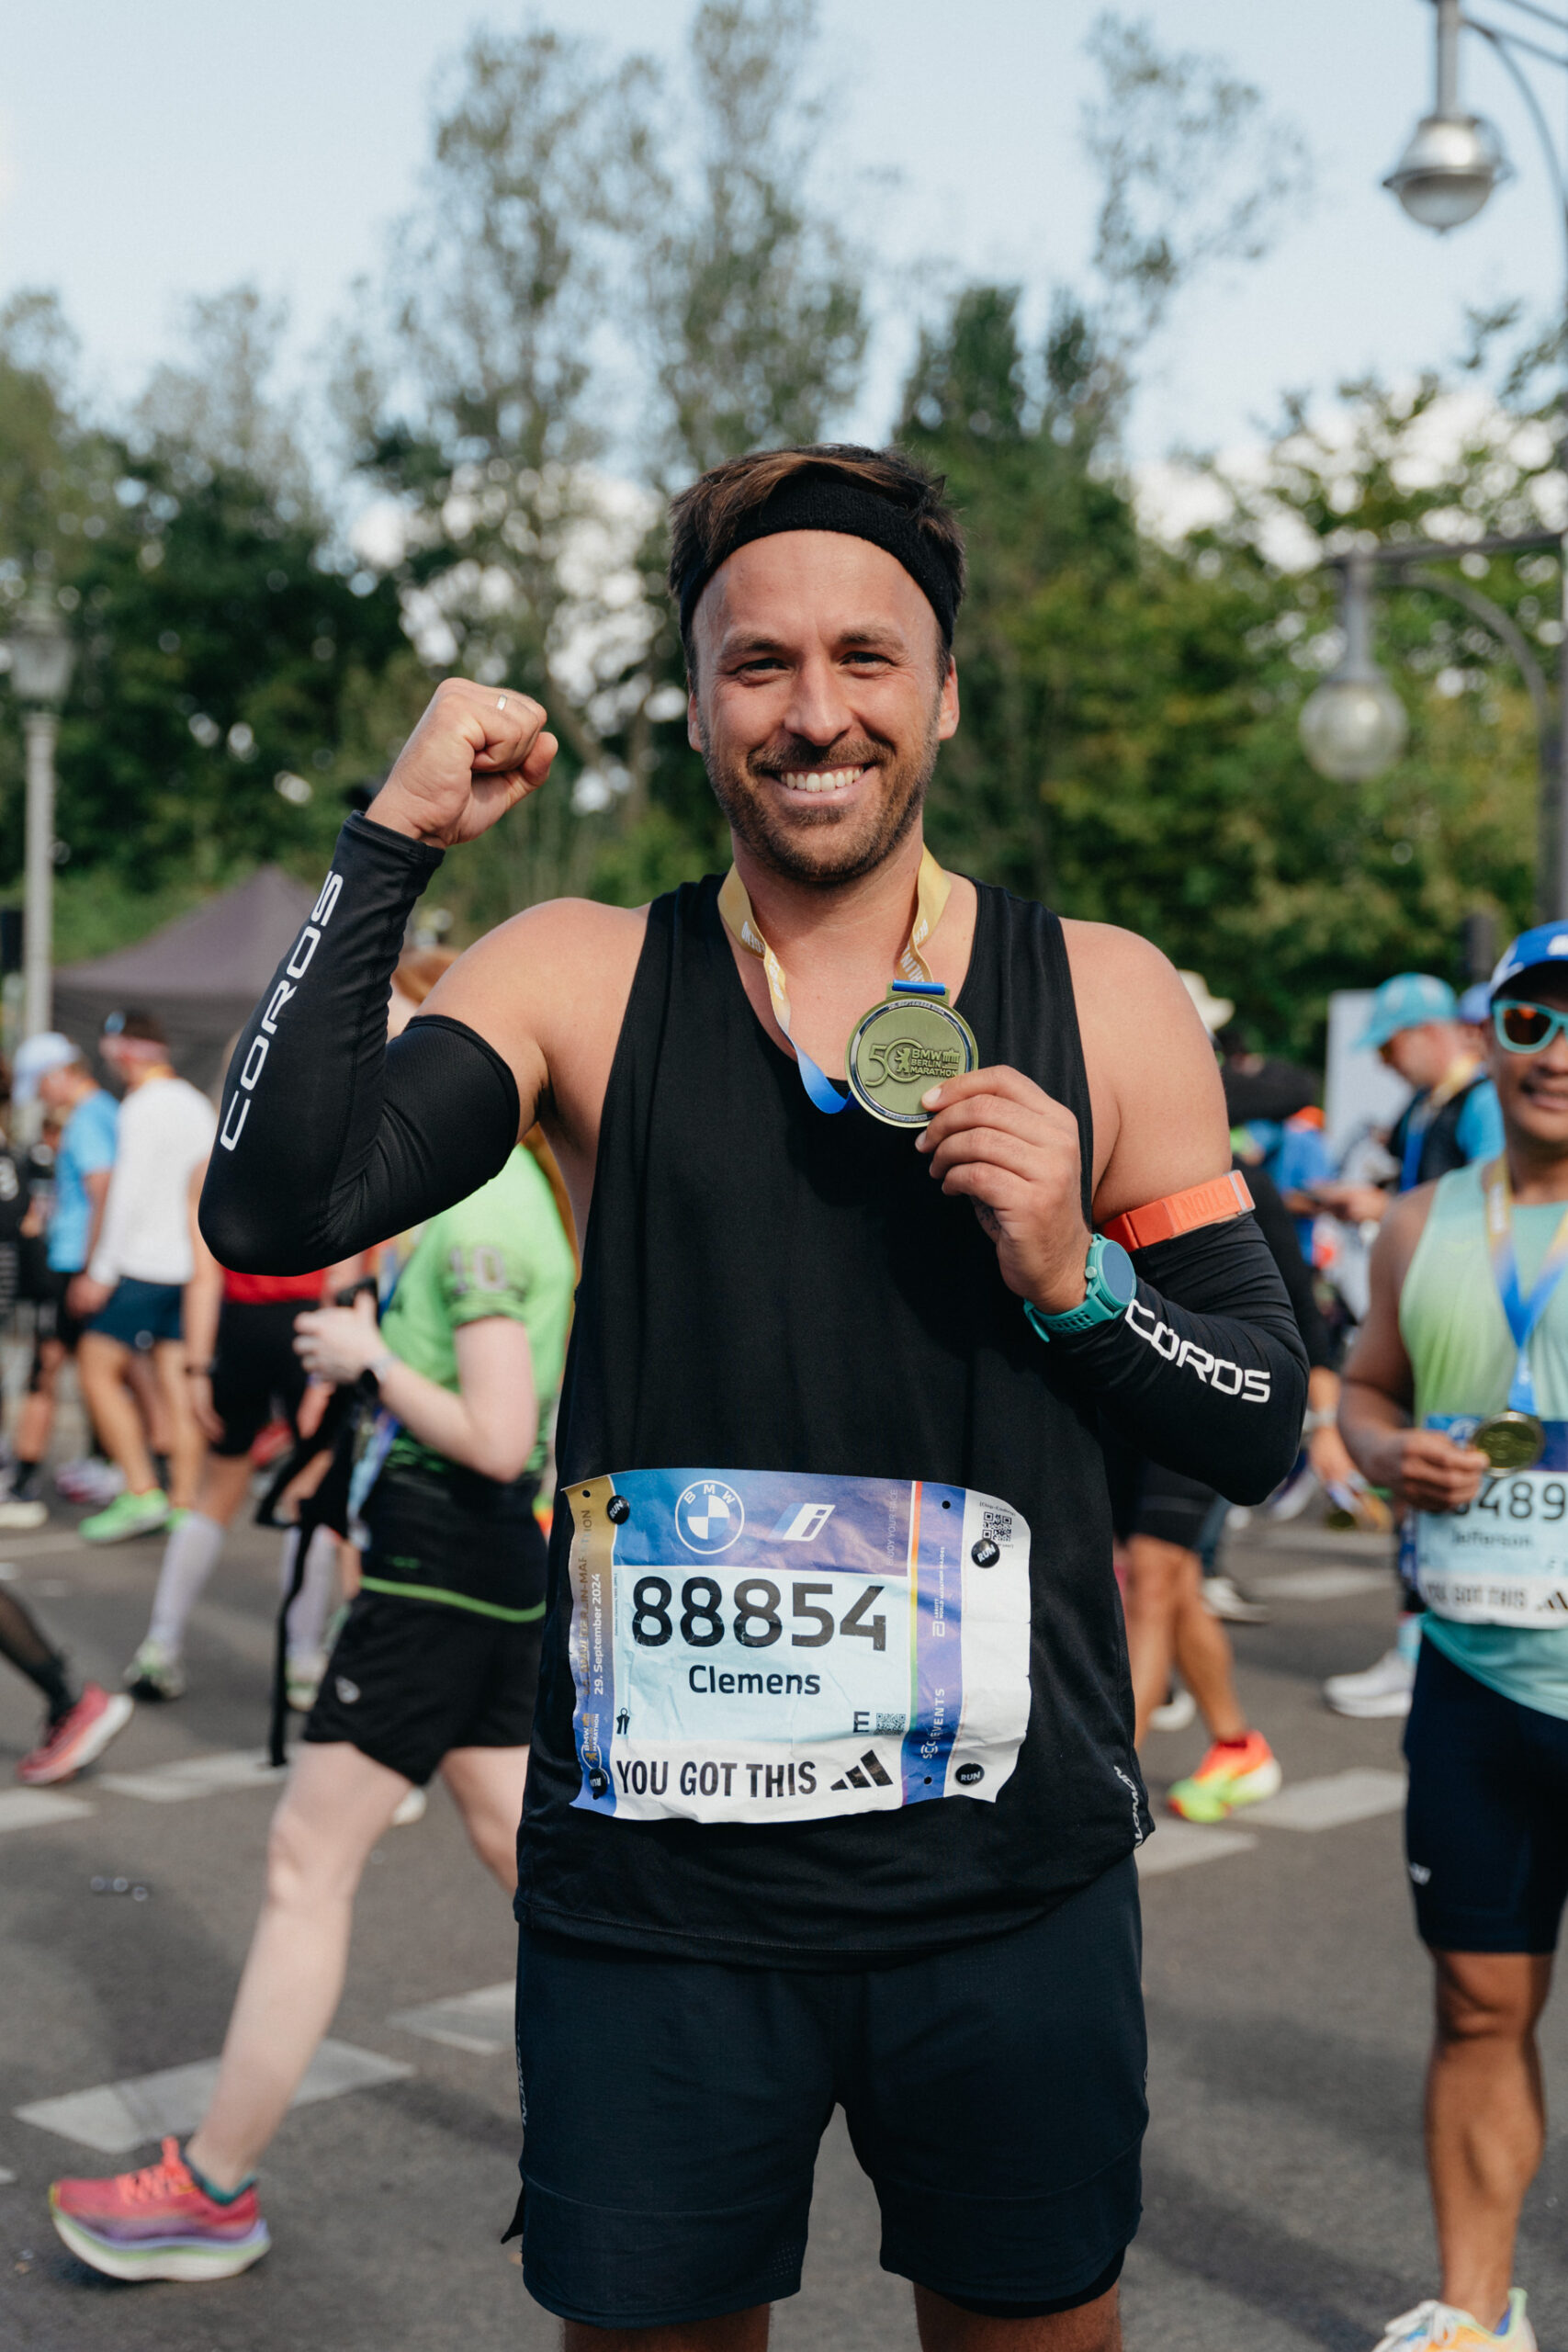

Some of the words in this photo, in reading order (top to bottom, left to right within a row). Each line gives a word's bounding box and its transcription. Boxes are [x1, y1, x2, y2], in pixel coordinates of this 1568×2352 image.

[220, 870, 344, 1151] COROS
[864, 1038, 923, 1087] 50
[910, 1048, 942, 1060] BMW
[910, 1058, 942, 1068] BERLIN
[910, 1066, 957, 1077] MARATHON
[1124, 1298, 1270, 1403] COROS
[683, 1484, 736, 1504] BMW
[609, 1499, 625, 1519] RUN
[887, 1514, 897, 1538] YOUR
[976, 1544, 997, 1563] RUN
[592, 1573, 602, 1605] 2024
[632, 1576, 886, 1652] 88854
[592, 1605, 604, 1672] September
[593, 1674, 604, 1695] 29.
[689, 1664, 820, 1695] Clemens
[852, 1711, 870, 1733] E
[931, 1688, 945, 1737] EVENTS
[616, 1760, 669, 1795] YOU
[680, 1761, 738, 1797] GOT
[746, 1760, 818, 1798] THIS
[960, 1770, 981, 1781] RUN
